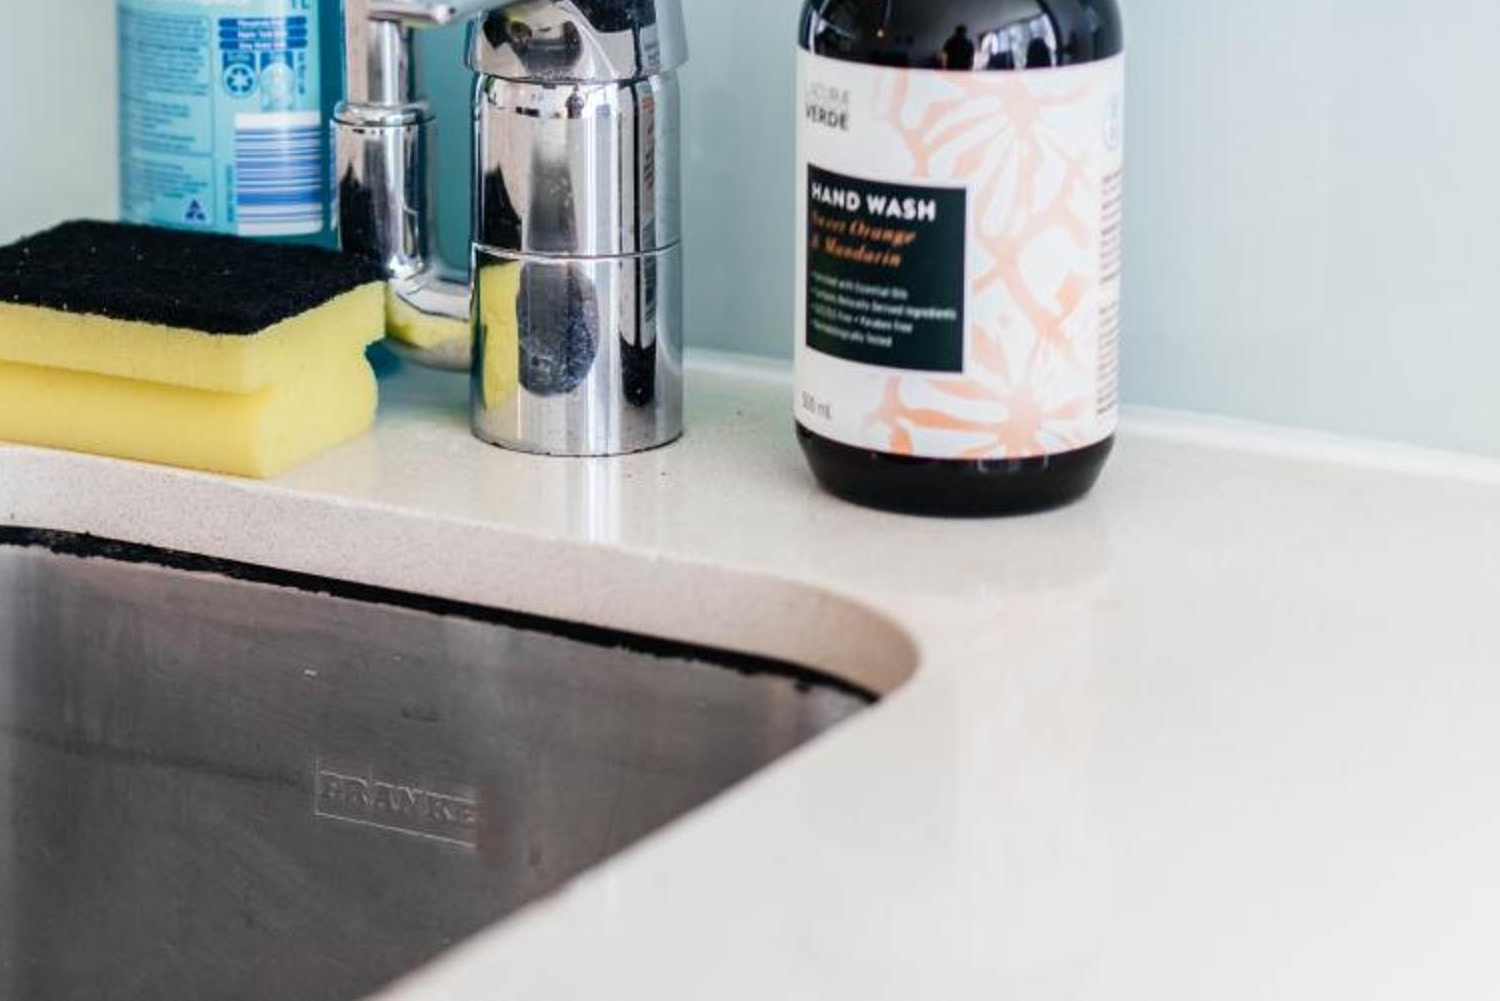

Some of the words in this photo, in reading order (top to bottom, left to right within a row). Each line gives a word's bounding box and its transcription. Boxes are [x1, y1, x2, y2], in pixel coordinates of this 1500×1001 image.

[805, 103, 849, 130] VERDE
[810, 182, 861, 212] HAND
[866, 193, 937, 222] WASH
[849, 219, 917, 247] Orange
[824, 237, 902, 266] Mandarin
